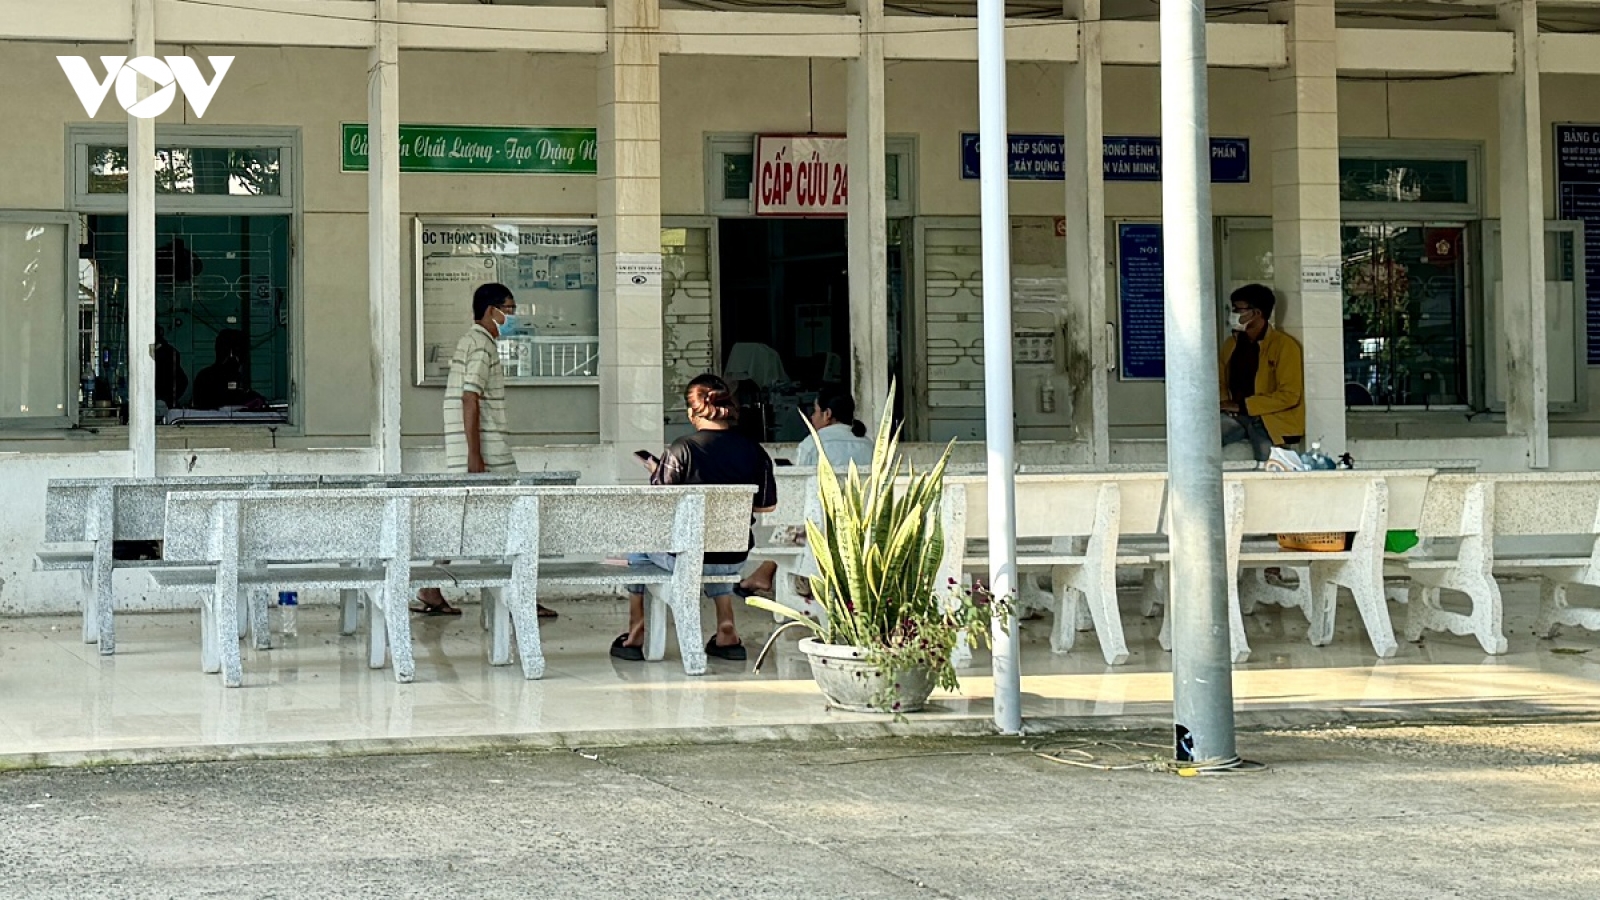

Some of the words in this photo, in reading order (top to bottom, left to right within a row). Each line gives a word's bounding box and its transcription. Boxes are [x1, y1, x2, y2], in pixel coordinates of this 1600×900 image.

[1563, 128, 1590, 143] BẢNG
[1592, 132, 1600, 143] G
[350, 133, 368, 156] Cả
[414, 135, 446, 157] Chất
[448, 137, 493, 164] Lượng
[504, 137, 532, 165] Tạo
[535, 138, 576, 165] Dựng
[1011, 139, 1030, 154] NẾP
[1031, 139, 1057, 154] SỐNG
[1103, 143, 1126, 156] RONG
[1129, 142, 1154, 159] BỆNH
[1014, 158, 1032, 172] XÂY
[1035, 159, 1060, 174] DỰNG
[1111, 160, 1130, 173] VĂN
[762, 146, 793, 206] CẤP
[796, 150, 829, 206] CỨU
[832, 162, 848, 206] 24
[439, 228, 477, 245] THÔNG
[519, 227, 560, 245] TRUYỀN
